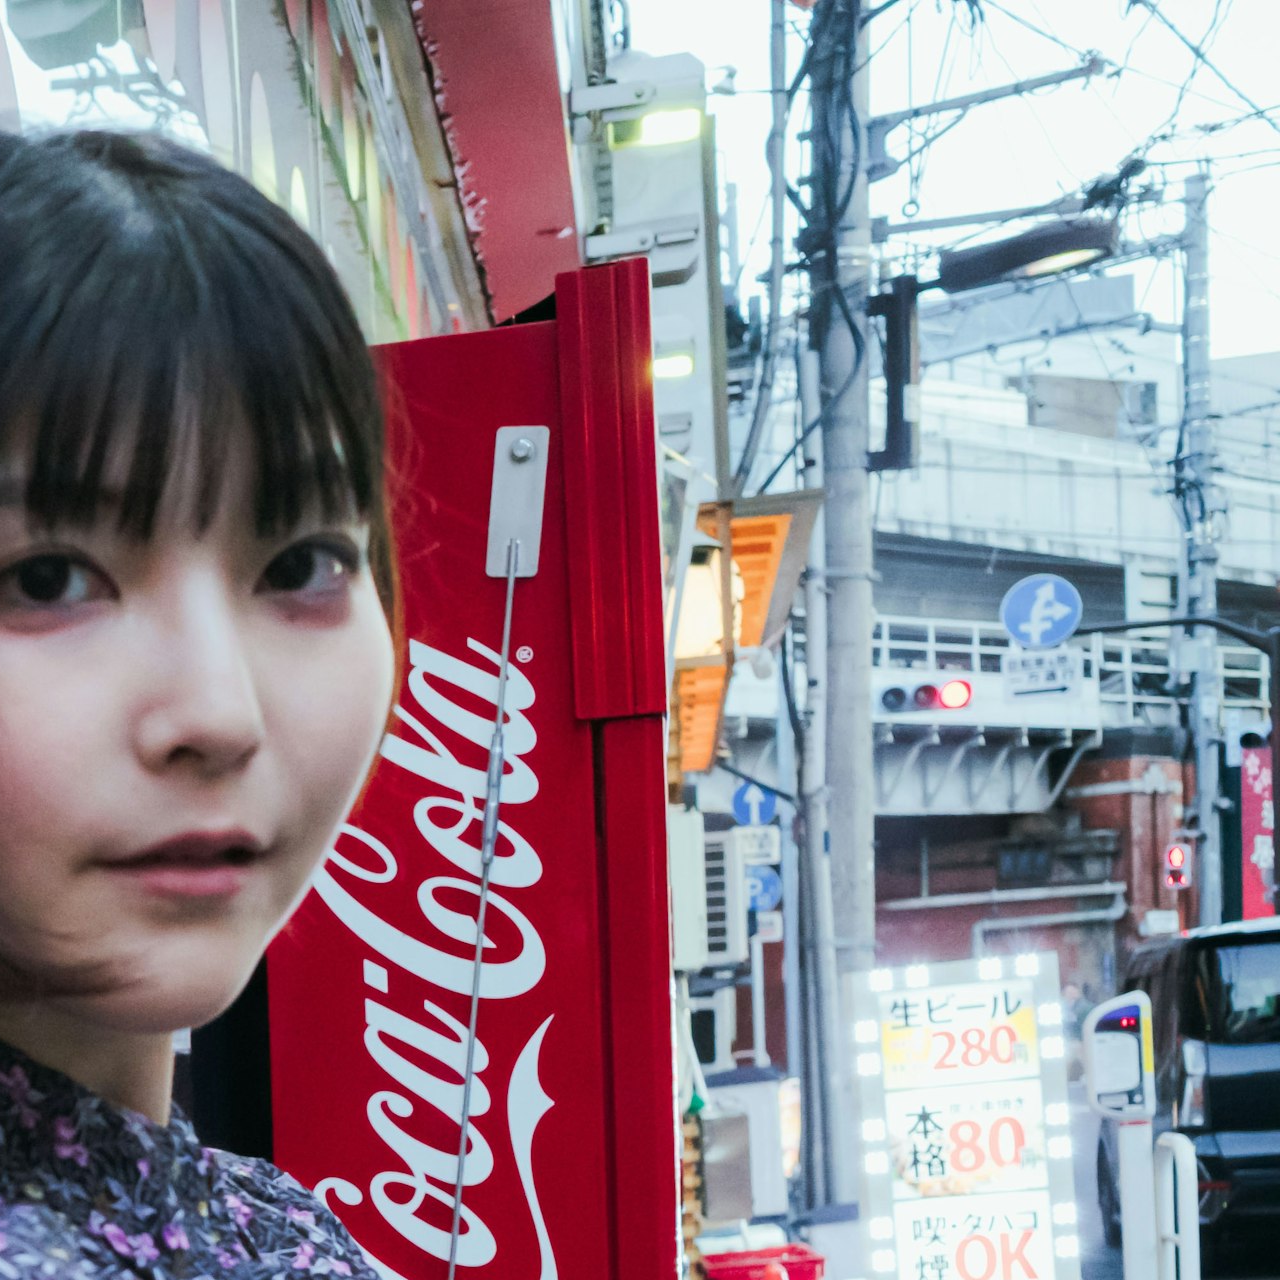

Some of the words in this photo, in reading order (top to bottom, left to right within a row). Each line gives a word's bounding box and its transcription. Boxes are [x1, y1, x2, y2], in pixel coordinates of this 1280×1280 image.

[889, 988, 1024, 1031] 生ビール
[904, 1104, 947, 1179] 本格
